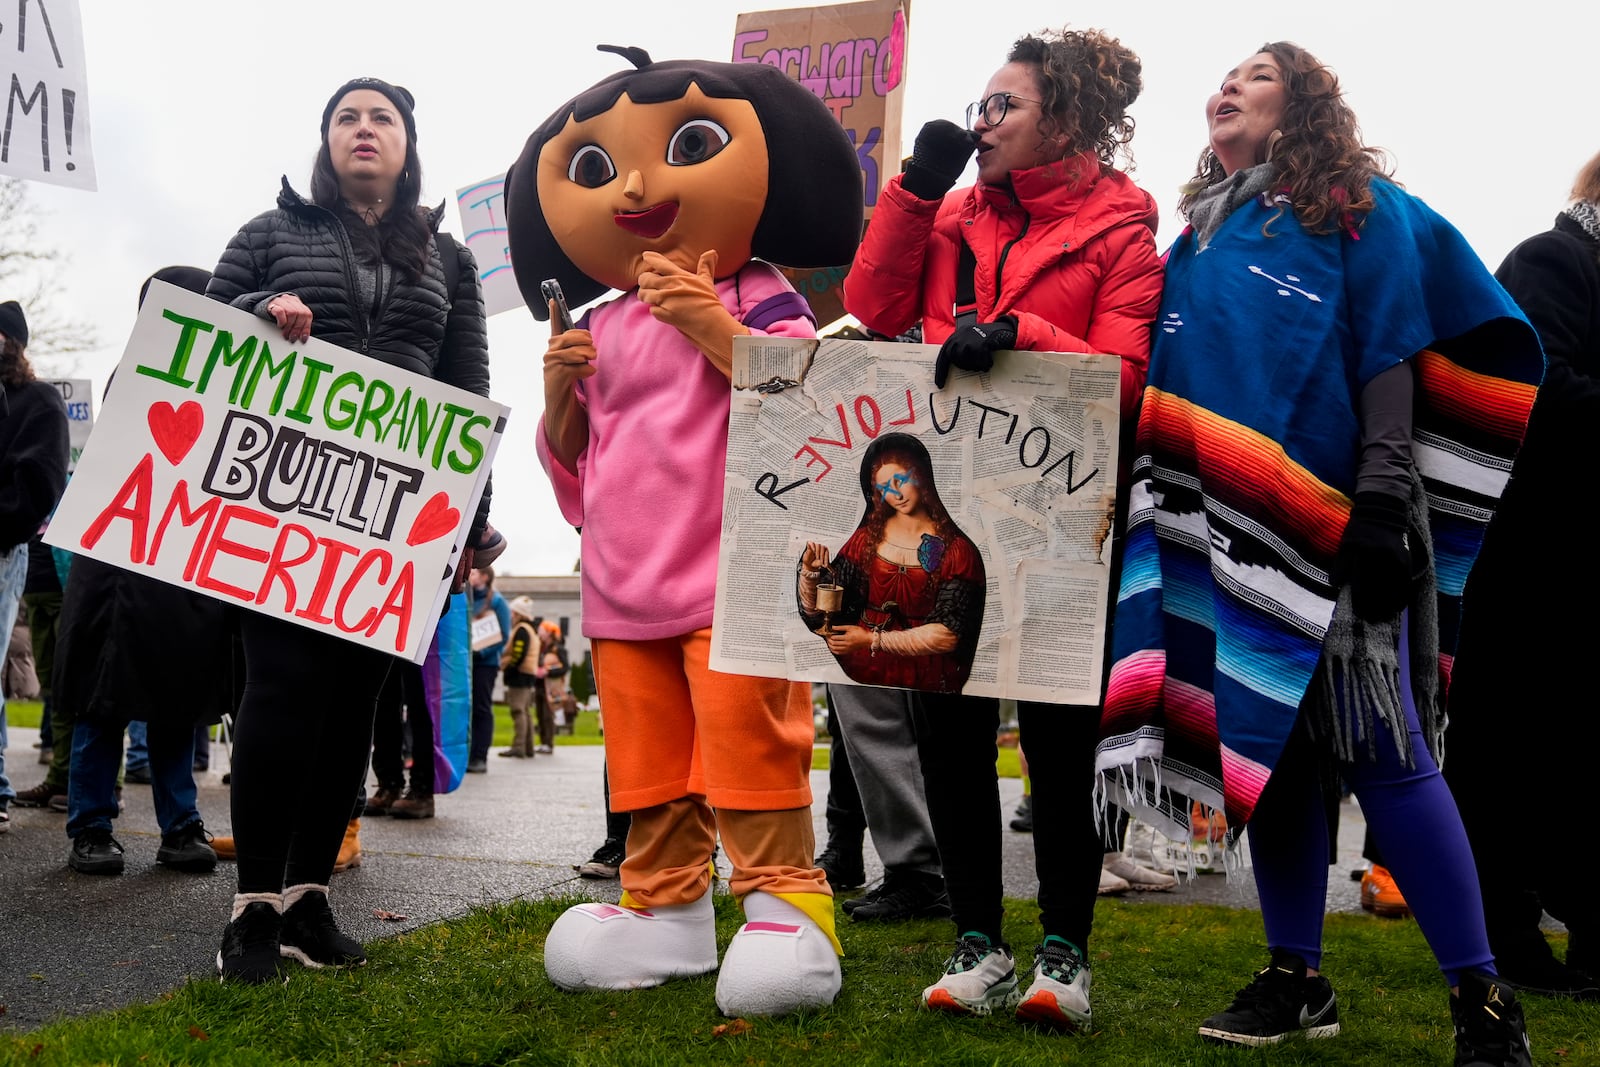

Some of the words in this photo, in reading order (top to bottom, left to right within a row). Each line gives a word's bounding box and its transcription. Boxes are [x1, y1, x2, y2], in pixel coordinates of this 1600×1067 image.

[0, 73, 76, 172] M!
[136, 309, 490, 475] IMMIGRANTS
[202, 410, 425, 542] BUILT
[81, 452, 414, 652] AMERICA
